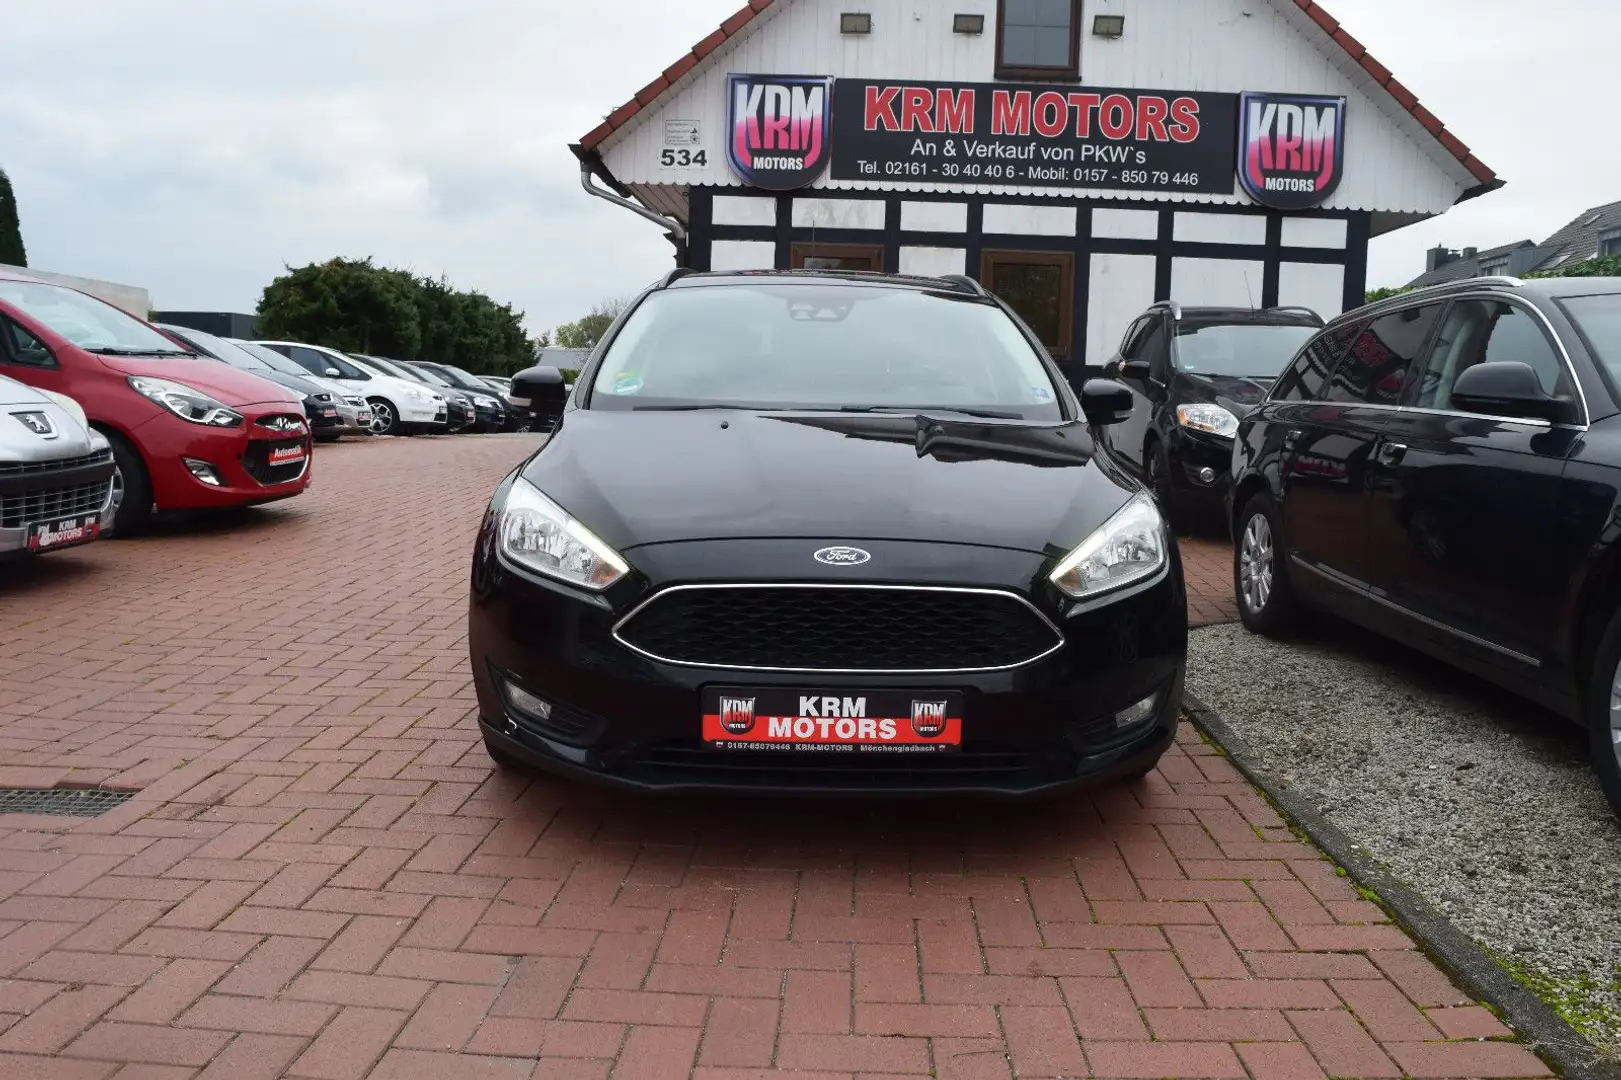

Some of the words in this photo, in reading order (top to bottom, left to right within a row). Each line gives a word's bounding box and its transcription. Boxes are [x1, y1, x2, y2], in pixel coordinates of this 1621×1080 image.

[864, 85, 975, 134] KRM
[991, 89, 1200, 143] MOTORS
[735, 84, 824, 168] KRM
[910, 138, 937, 156] An
[943, 139, 957, 157] &
[963, 139, 1037, 160] Verkauf
[1041, 146, 1074, 161] von
[1248, 102, 1336, 191] KRM
[661, 149, 707, 167] 534
[753, 156, 804, 171] MOTORS
[857, 160, 881, 174] Tel.
[885, 161, 927, 175] 02161
[942, 163, 959, 177] 30
[963, 164, 980, 177] 40
[984, 165, 1001, 178] 40
[1005, 165, 1015, 179] 6
[1028, 166, 1069, 181] Mobil:
[1073, 167, 1109, 182] 0157
[1121, 170, 1148, 184] 850
[1151, 171, 1169, 185] 79
[1172, 172, 1199, 186] 446
[1265, 177, 1315, 192] MOTORS
[58, 519, 77, 531] KRM
[826, 550, 858, 561] Ford
[799, 696, 867, 717] KRM
[768, 717, 897, 739] MOTORS
[795, 743, 853, 751] KRM-MOTORS
